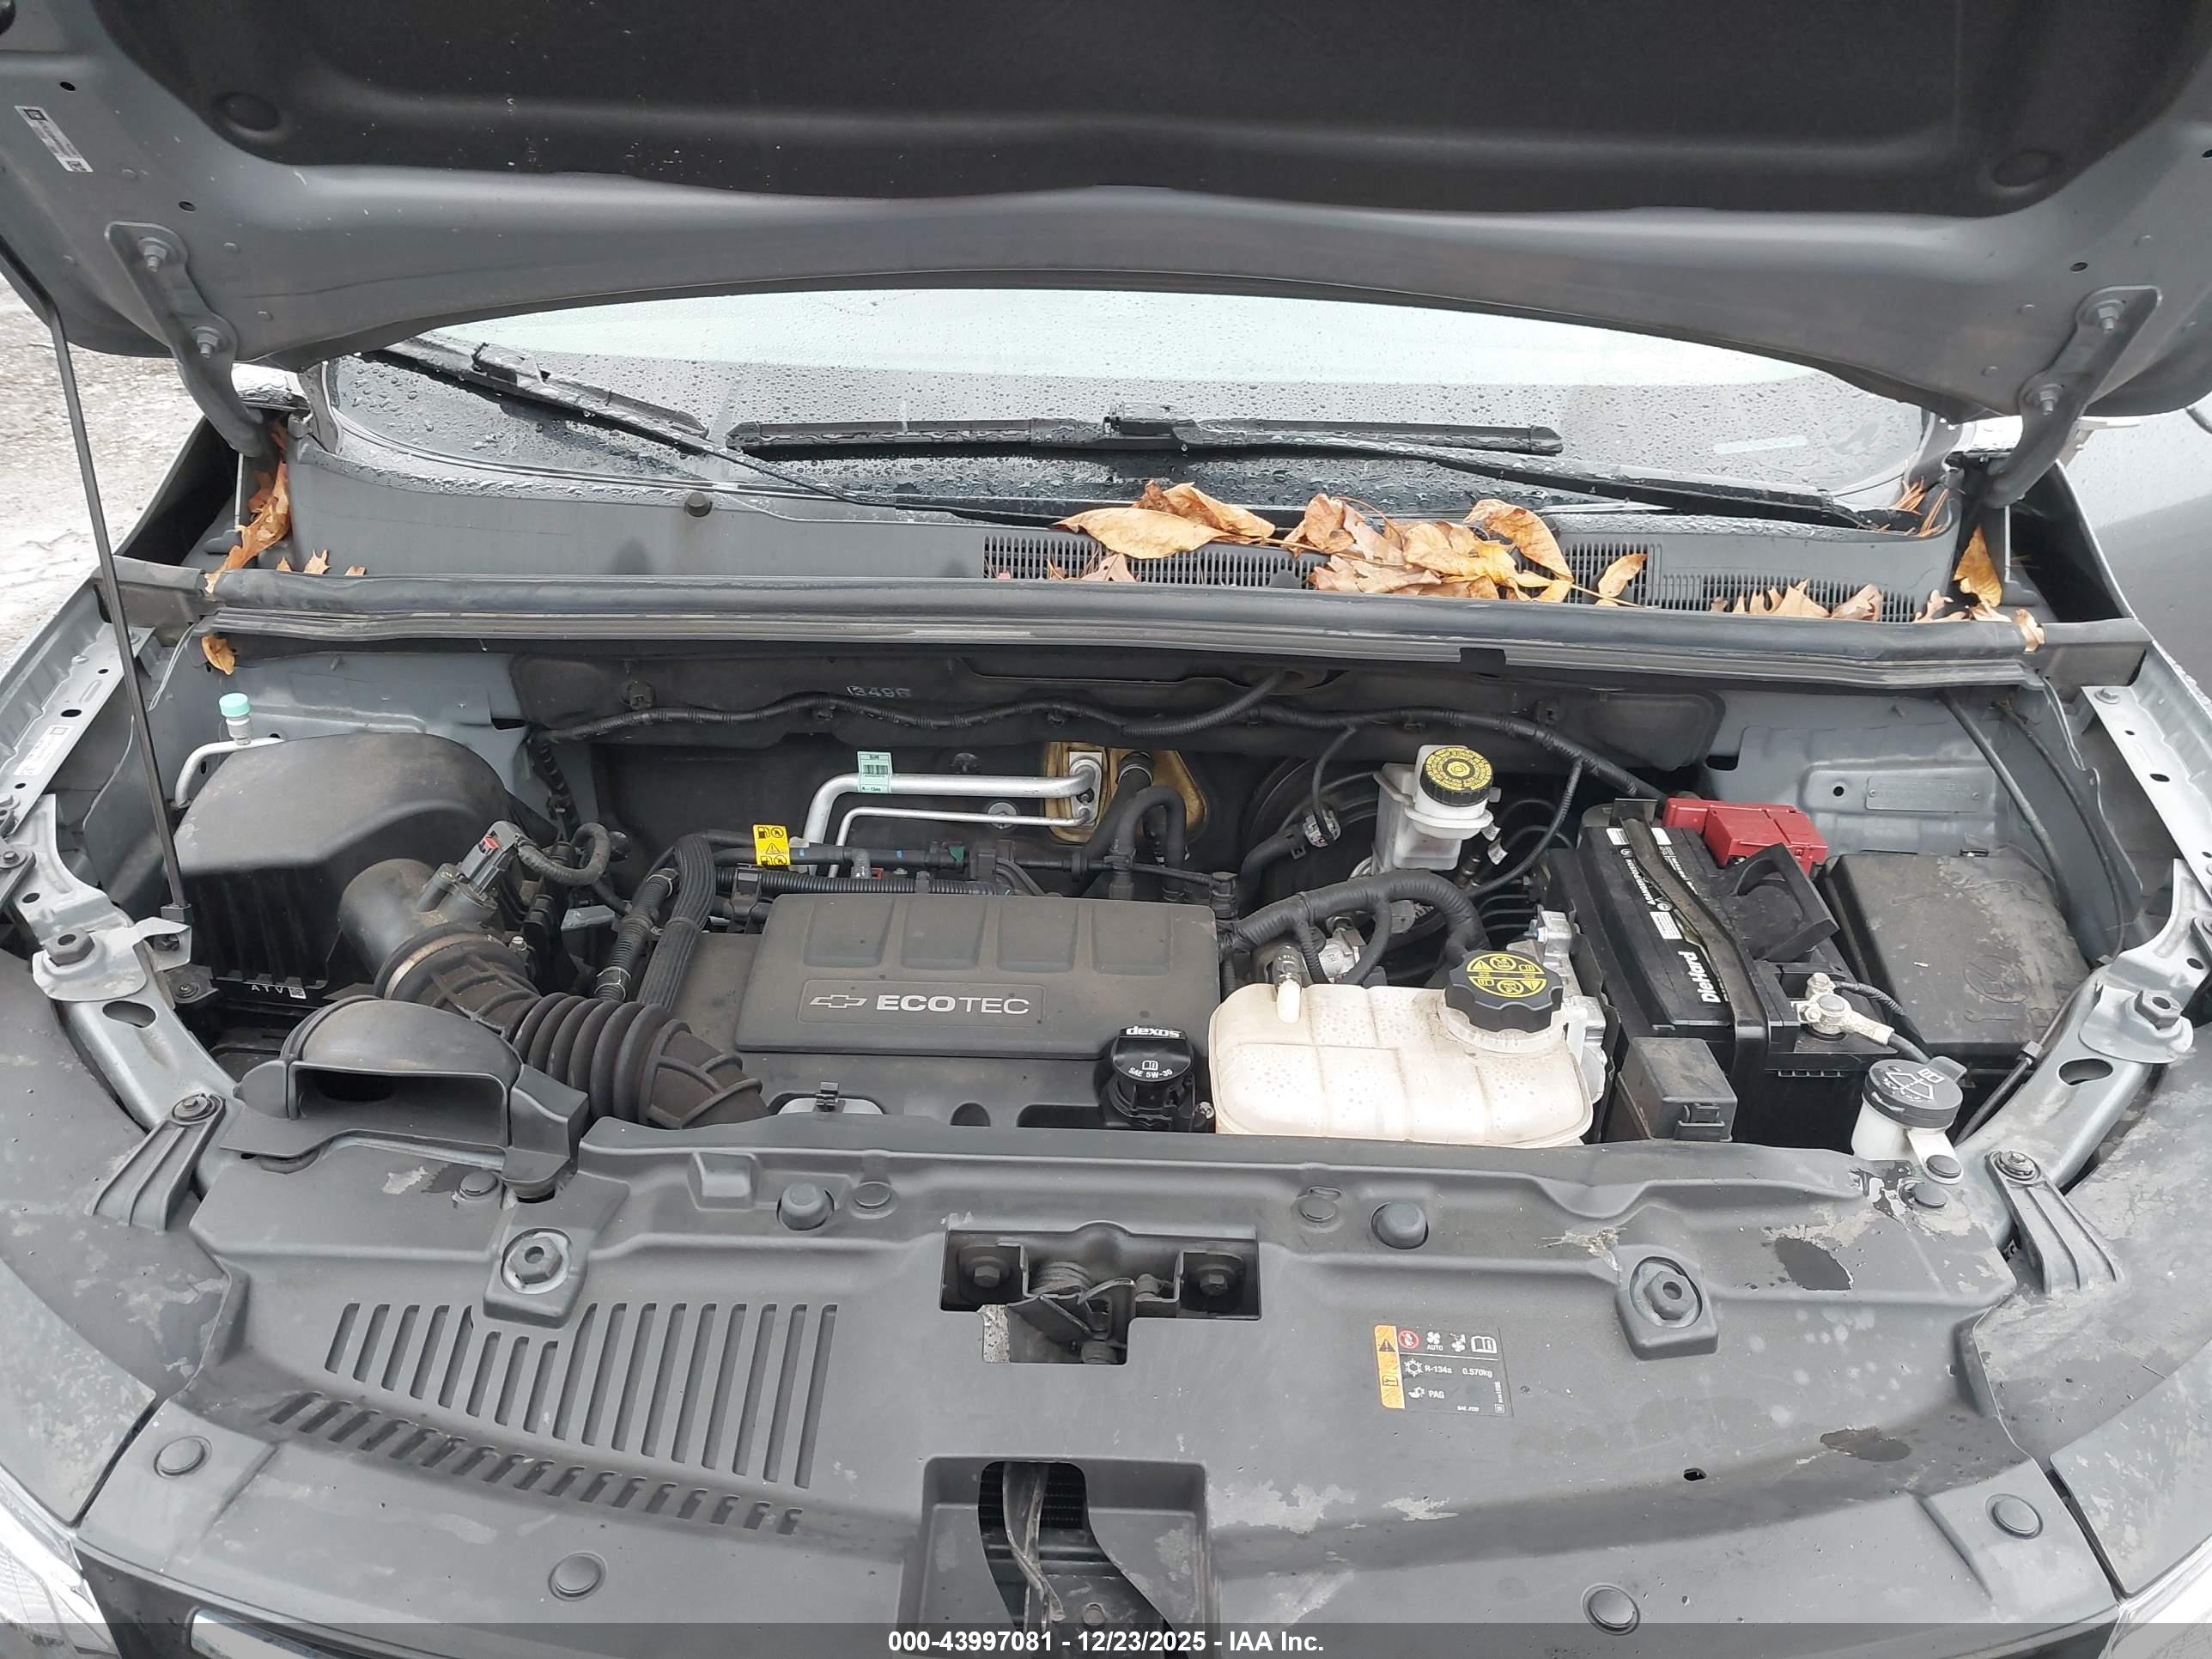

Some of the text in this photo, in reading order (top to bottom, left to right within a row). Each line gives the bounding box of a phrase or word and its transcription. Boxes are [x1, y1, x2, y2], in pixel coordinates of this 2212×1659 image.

[1677, 951, 1722, 1003] DieHard
[876, 994, 1030, 1015] ECOTEC
[1126, 1025, 1182, 1038] dexos
[1128, 1066, 1173, 1079] SAE 5W-30
[1425, 1364, 1493, 1378] R-134a 0.570kg
[1428, 1390, 1445, 1399] PAG
